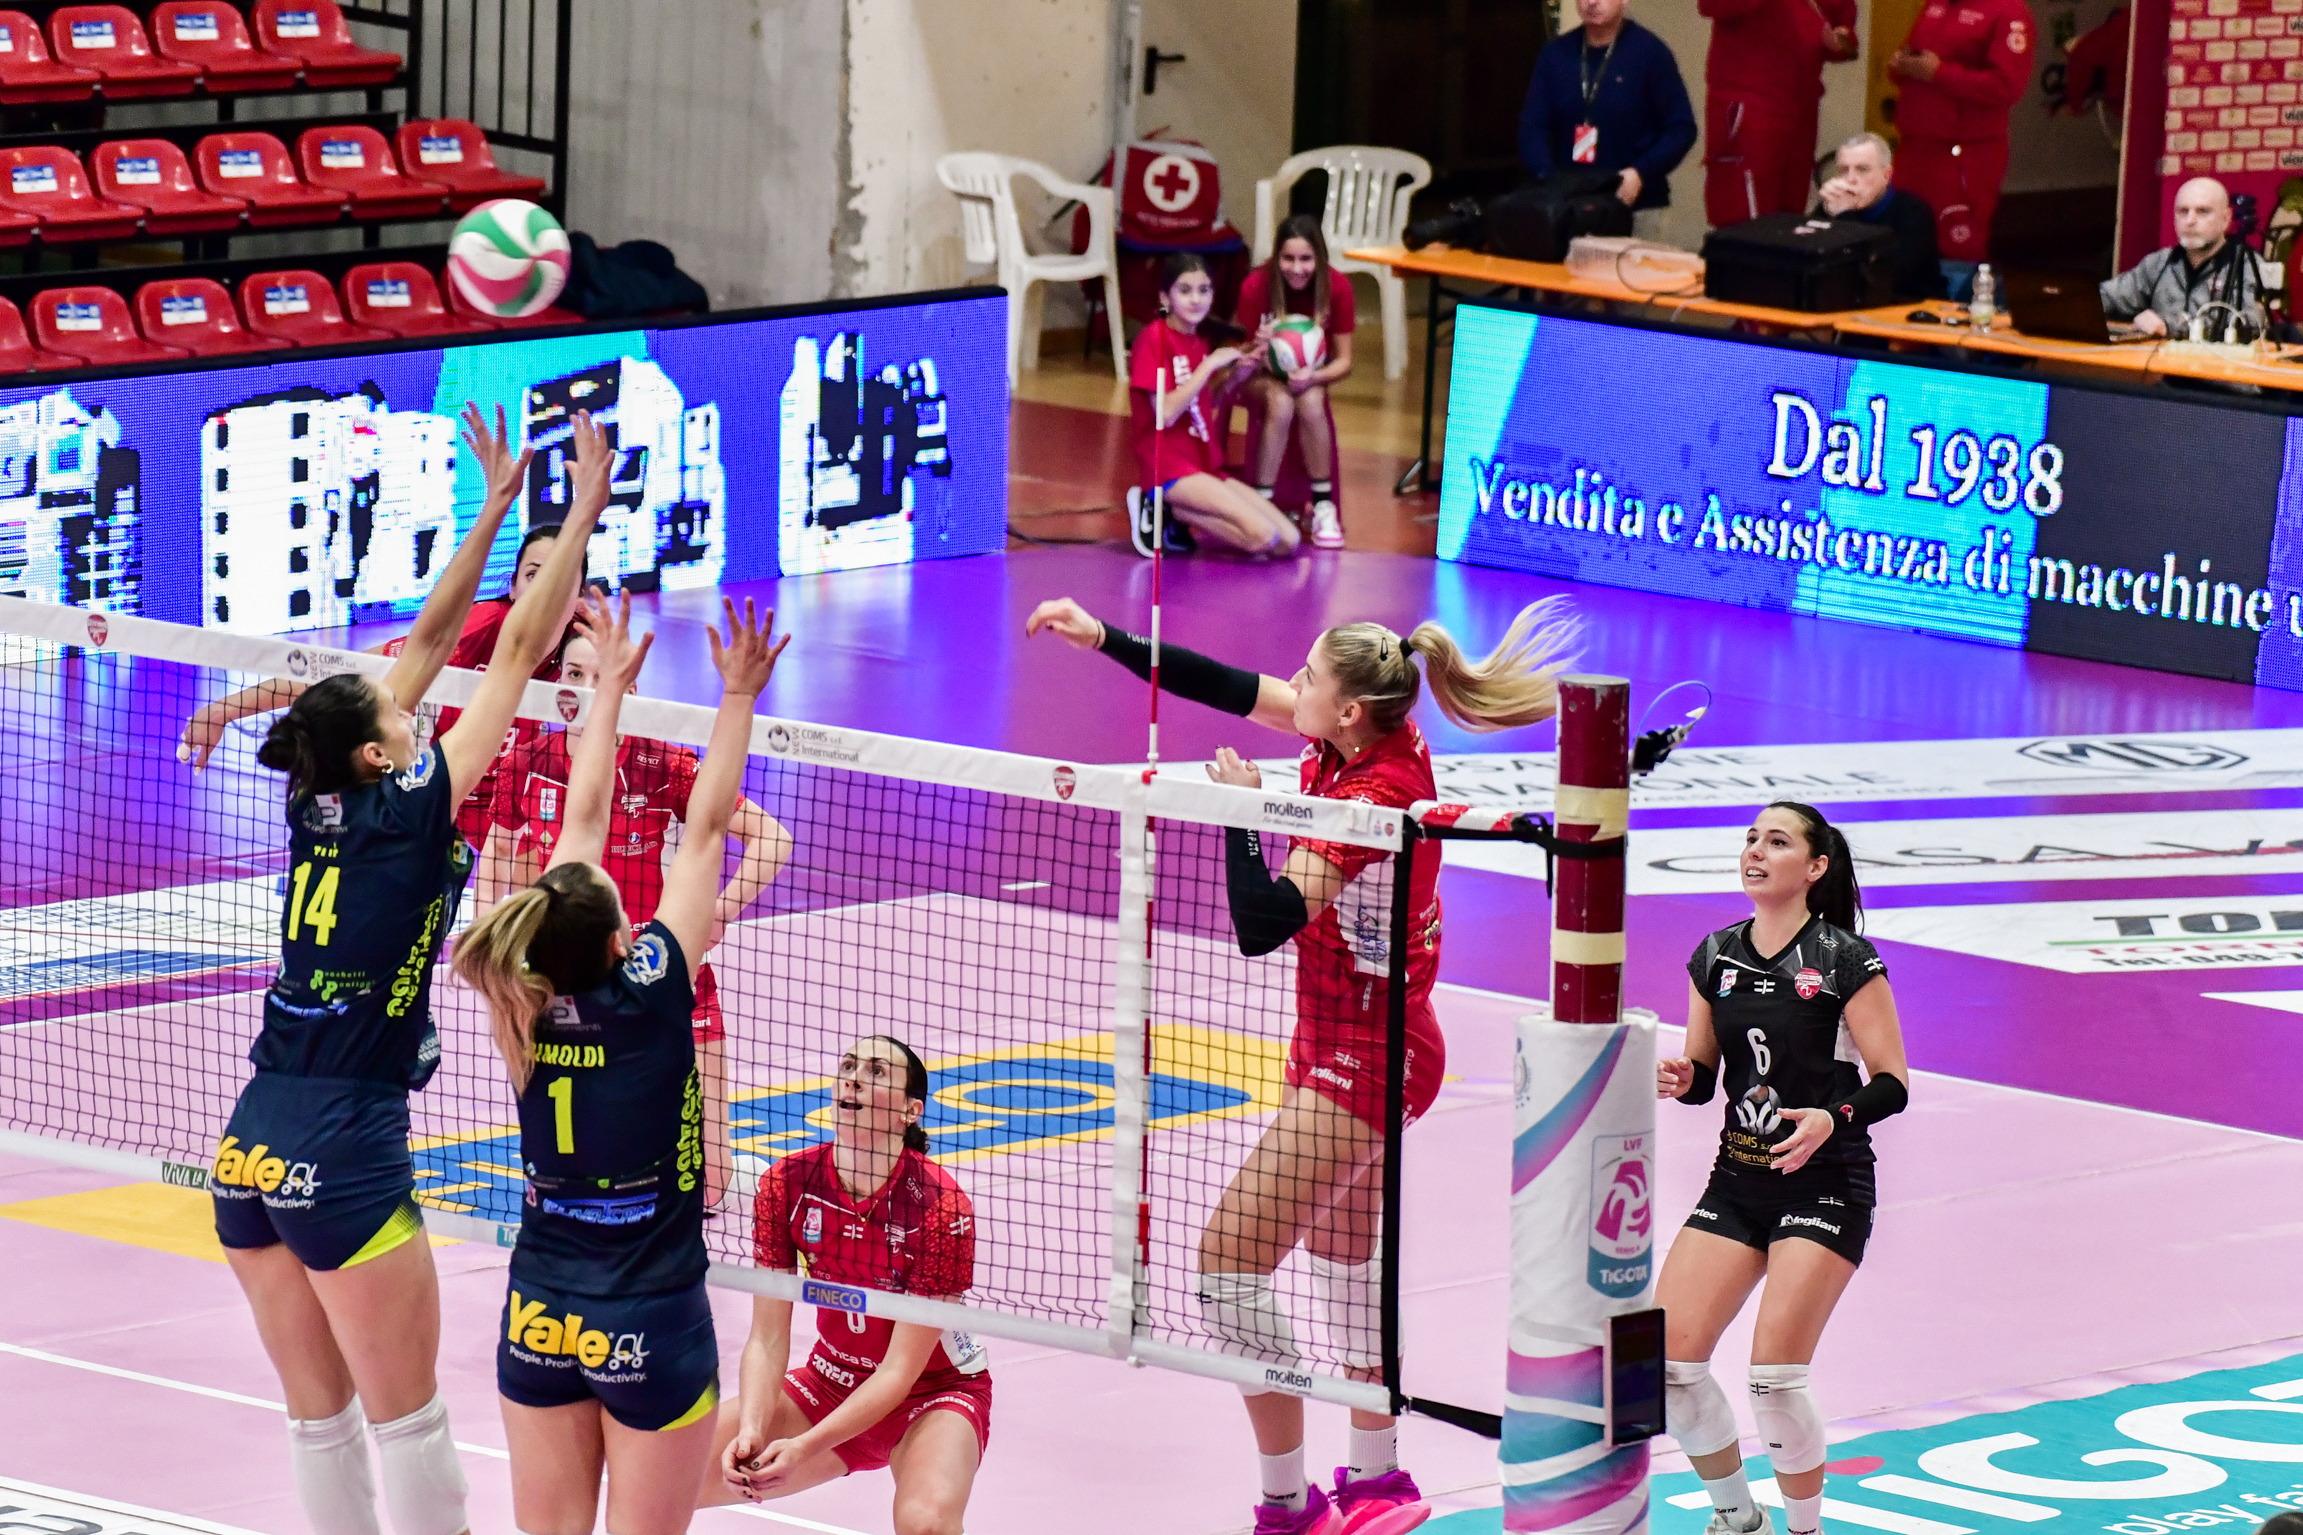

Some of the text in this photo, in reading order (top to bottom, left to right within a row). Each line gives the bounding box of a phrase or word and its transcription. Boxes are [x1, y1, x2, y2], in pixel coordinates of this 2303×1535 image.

[1767, 392, 2064, 516] Dal 1938
[1471, 458, 1645, 538] Vendita
[1657, 503, 1684, 543] e
[1694, 494, 1949, 584] Assistenza
[1964, 527, 2011, 594] di
[2027, 552, 2273, 631] macchine
[1264, 802, 1313, 819] molten
[287, 861, 341, 947] 14
[532, 1042, 605, 1068] IMOLDI
[1747, 1028, 1771, 1076] 6
[548, 1076, 575, 1155] 1
[1732, 1132, 1758, 1149] COMS
[1733, 1149, 1781, 1165] Internatio
[807, 1286, 862, 1309] FINECO
[508, 1290, 611, 1368] Yale
[1265, 1369, 1312, 1389] molten
